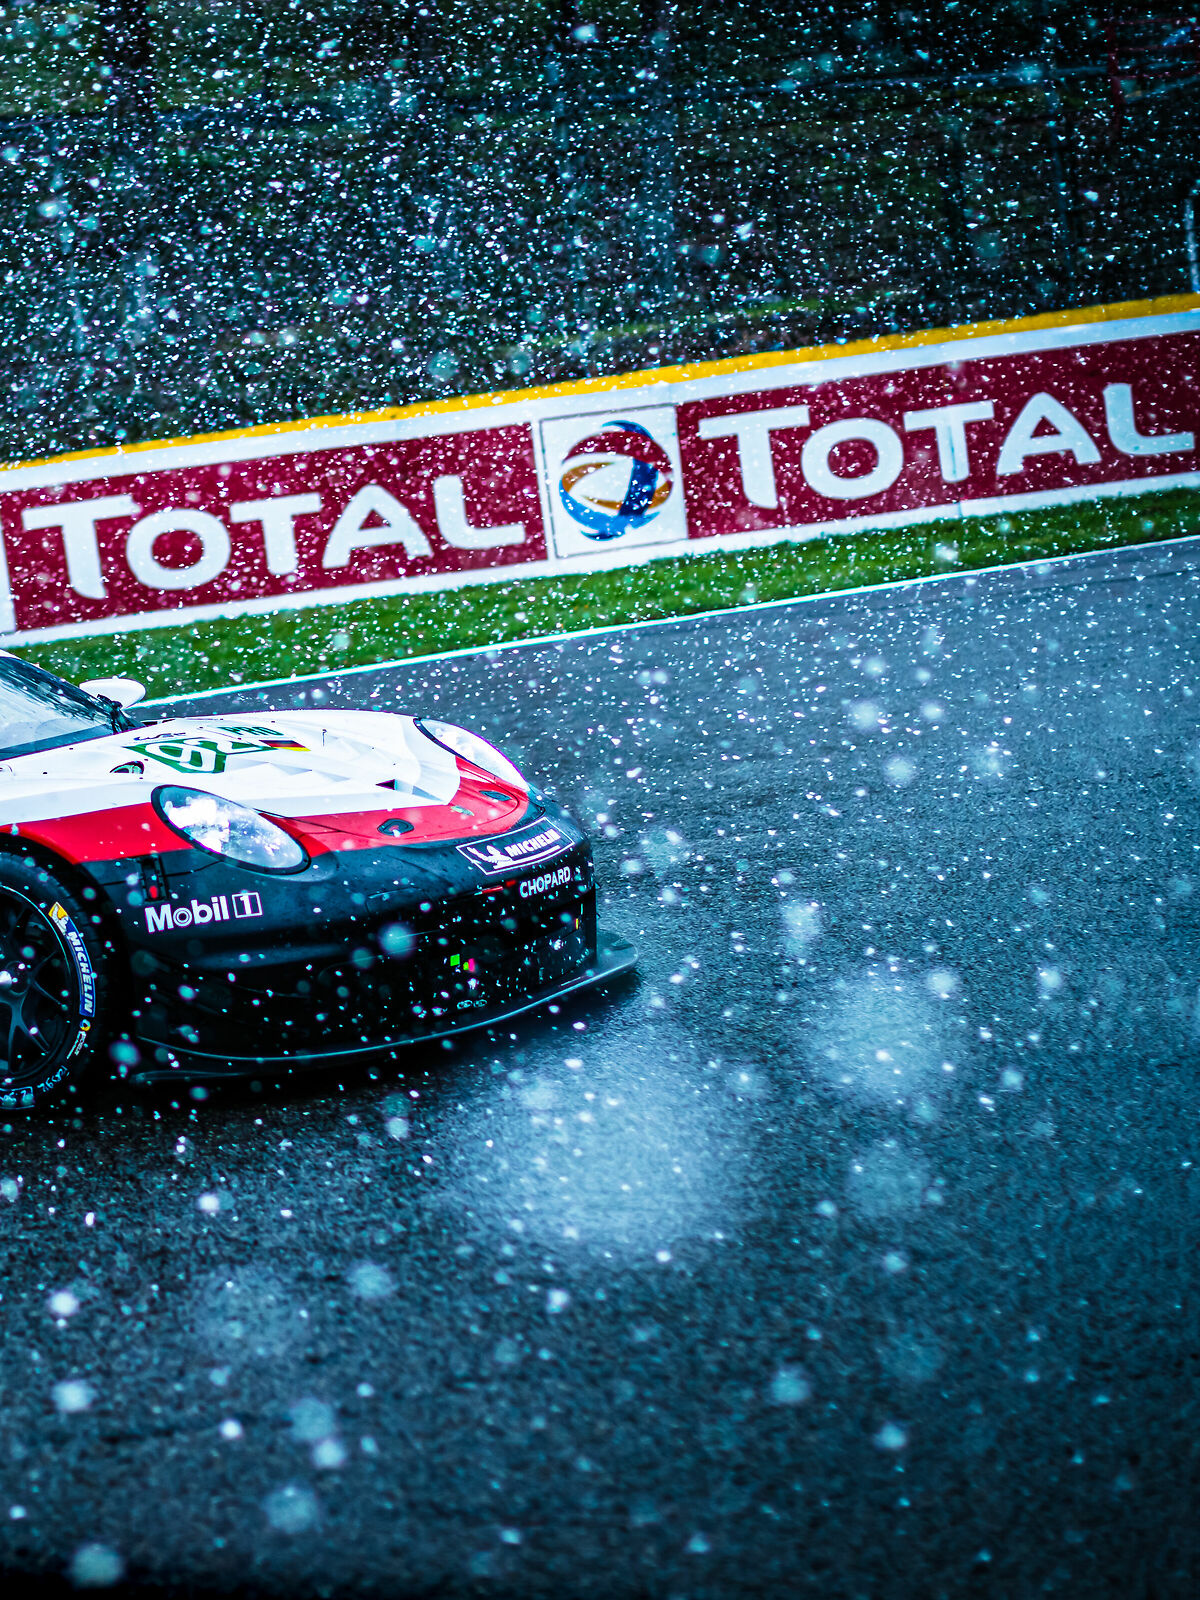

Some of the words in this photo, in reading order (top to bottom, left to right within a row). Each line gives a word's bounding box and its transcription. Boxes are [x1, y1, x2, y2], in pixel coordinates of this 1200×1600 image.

[699, 382, 1196, 510] TOTAL
[20, 474, 526, 601] TOTAL
[504, 829, 561, 857] MICHELIN
[520, 866, 571, 898] CHOPARD
[144, 895, 230, 933] Mobil
[67, 931, 93, 1014] MICHELIN
